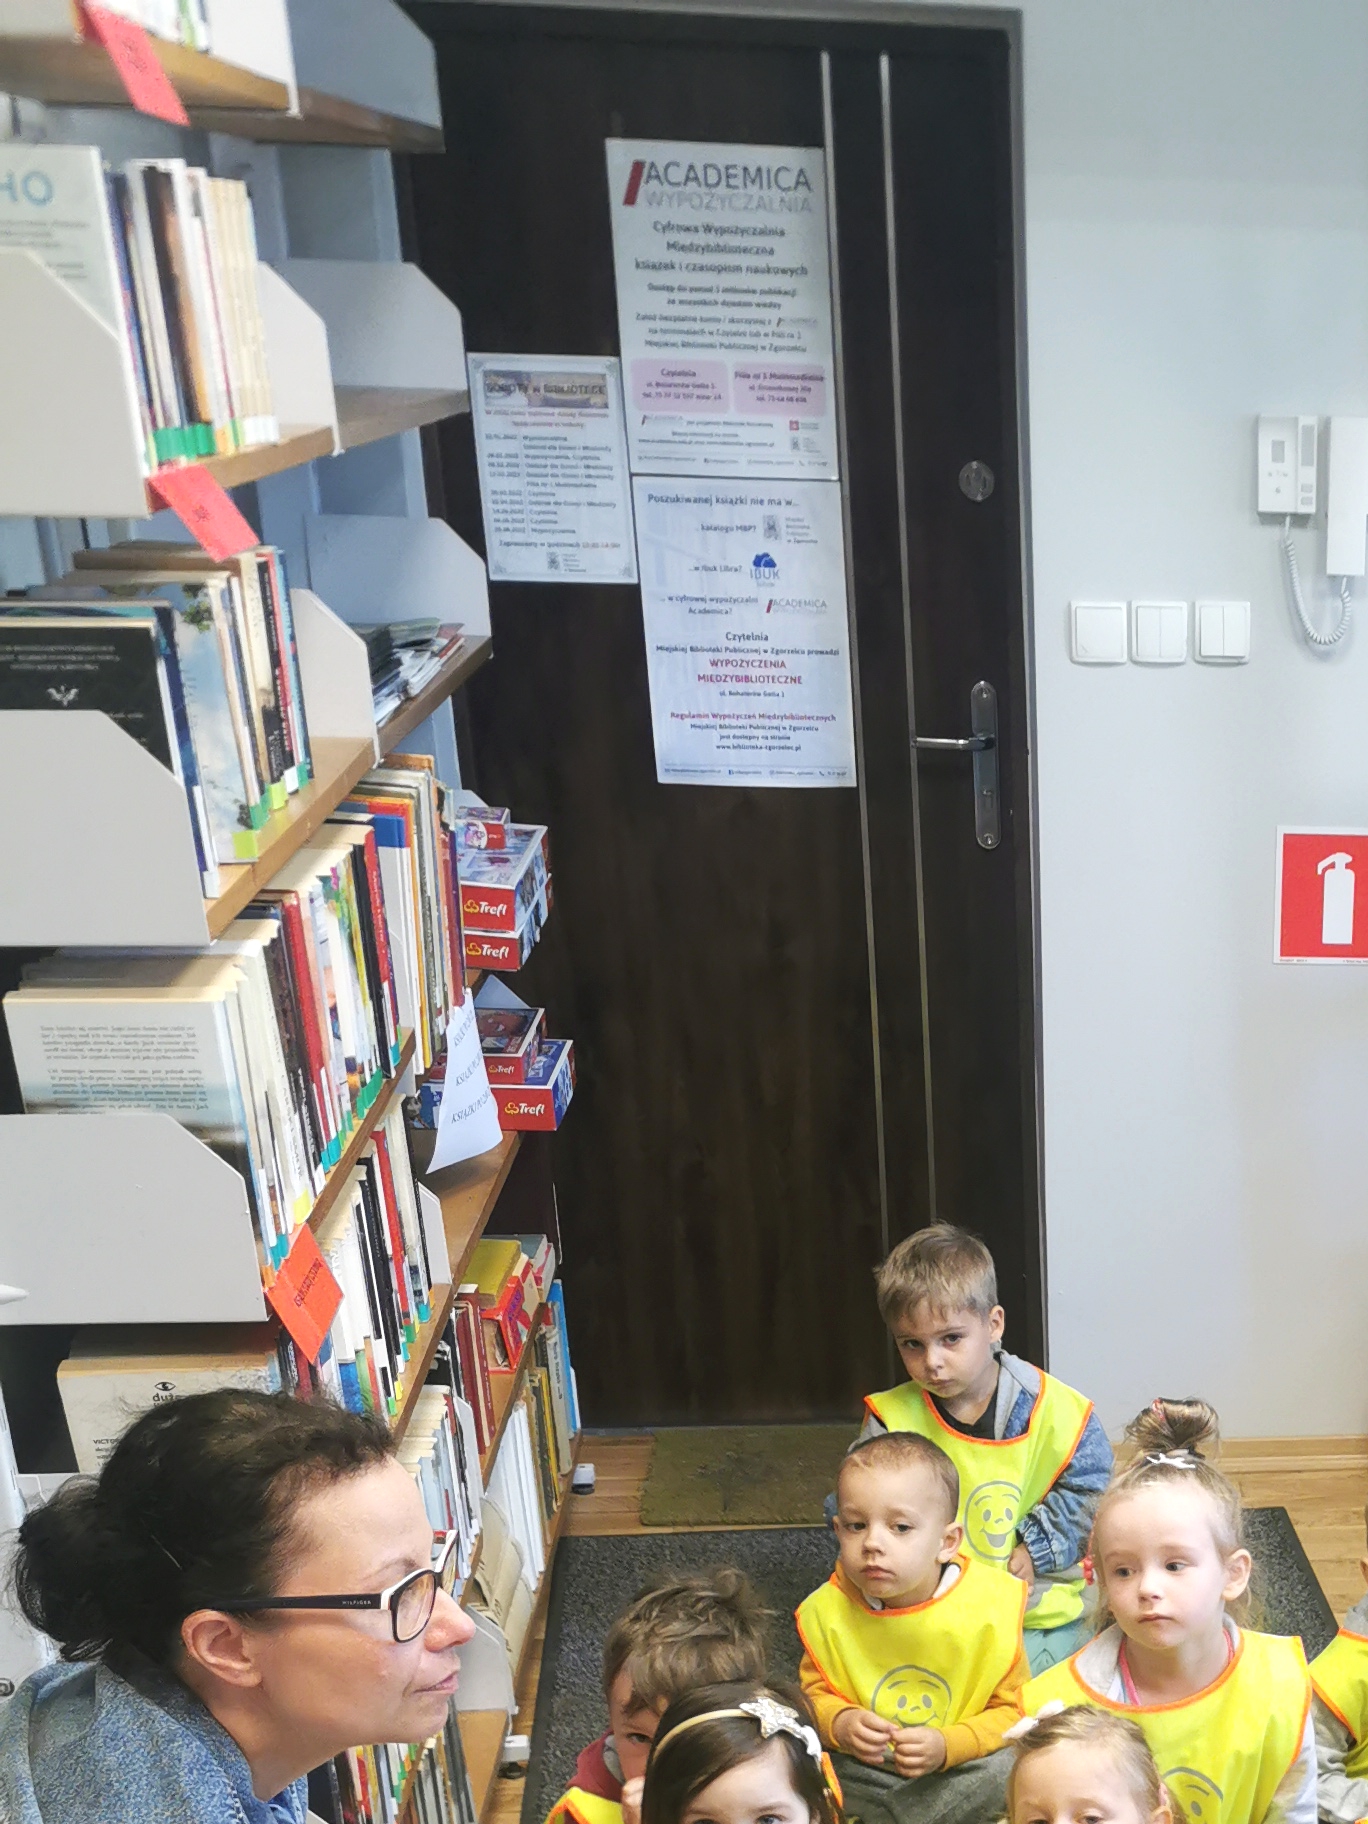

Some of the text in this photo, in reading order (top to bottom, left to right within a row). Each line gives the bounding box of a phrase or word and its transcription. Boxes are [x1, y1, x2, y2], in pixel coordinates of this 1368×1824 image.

[645, 160, 813, 192] ACADEMICA
[479, 901, 506, 917] Trefl
[482, 944, 509, 959] Trefl
[497, 1065, 514, 1074] Trefl
[519, 1102, 545, 1116] Trefl
